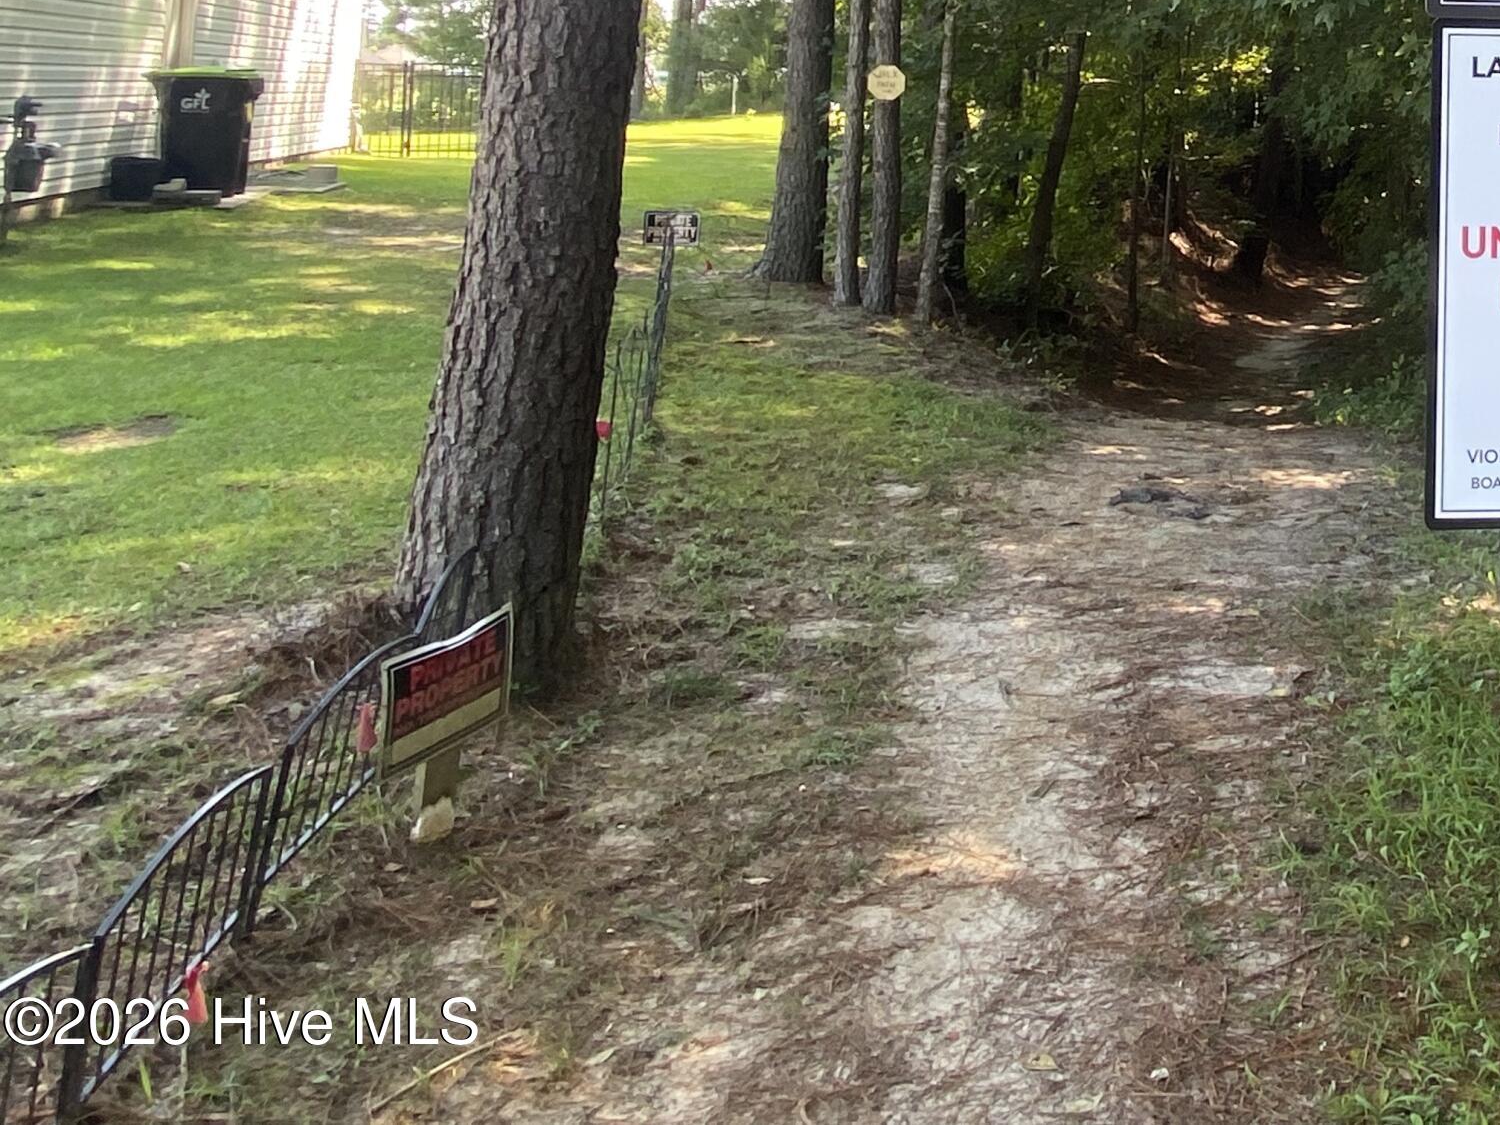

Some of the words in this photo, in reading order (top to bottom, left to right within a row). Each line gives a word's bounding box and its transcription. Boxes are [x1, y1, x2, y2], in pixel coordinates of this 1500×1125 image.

[180, 92, 210, 110] GFL
[648, 226, 697, 238] PROERTY
[410, 628, 497, 692] PRIVATE
[395, 651, 504, 721] PROPERTY
